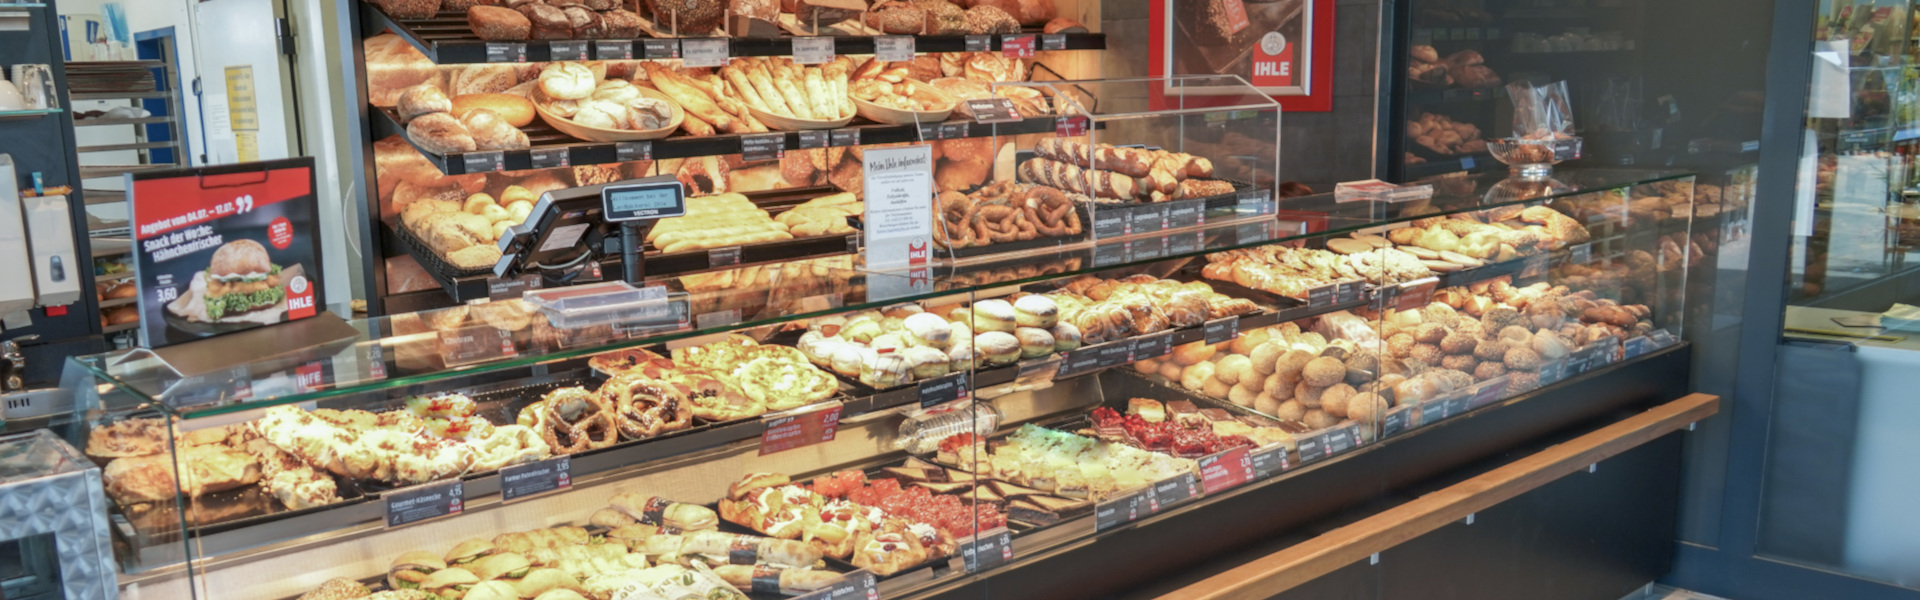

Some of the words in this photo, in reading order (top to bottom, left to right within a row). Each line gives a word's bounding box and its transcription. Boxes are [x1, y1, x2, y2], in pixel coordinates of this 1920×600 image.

[1254, 61, 1290, 76] IHLE
[869, 161, 885, 172] Mein
[140, 218, 172, 235] Angebot
[171, 213, 187, 227] vom
[186, 209, 209, 222] 04.07.
[143, 235, 170, 253] Snack
[170, 230, 185, 245] der
[185, 224, 213, 241] Woche:
[152, 234, 224, 263] Hähnchenfrischer
[910, 250, 926, 259] IHLE
[156, 287, 177, 302] 3,60
[288, 295, 313, 310] IHLE
[497, 329, 511, 339] 1,90
[823, 412, 839, 423] 2,00
[556, 461, 570, 472] 3,95
[448, 486, 462, 498] 4,15
[391, 493, 442, 508] Gourmet-Käseecke
